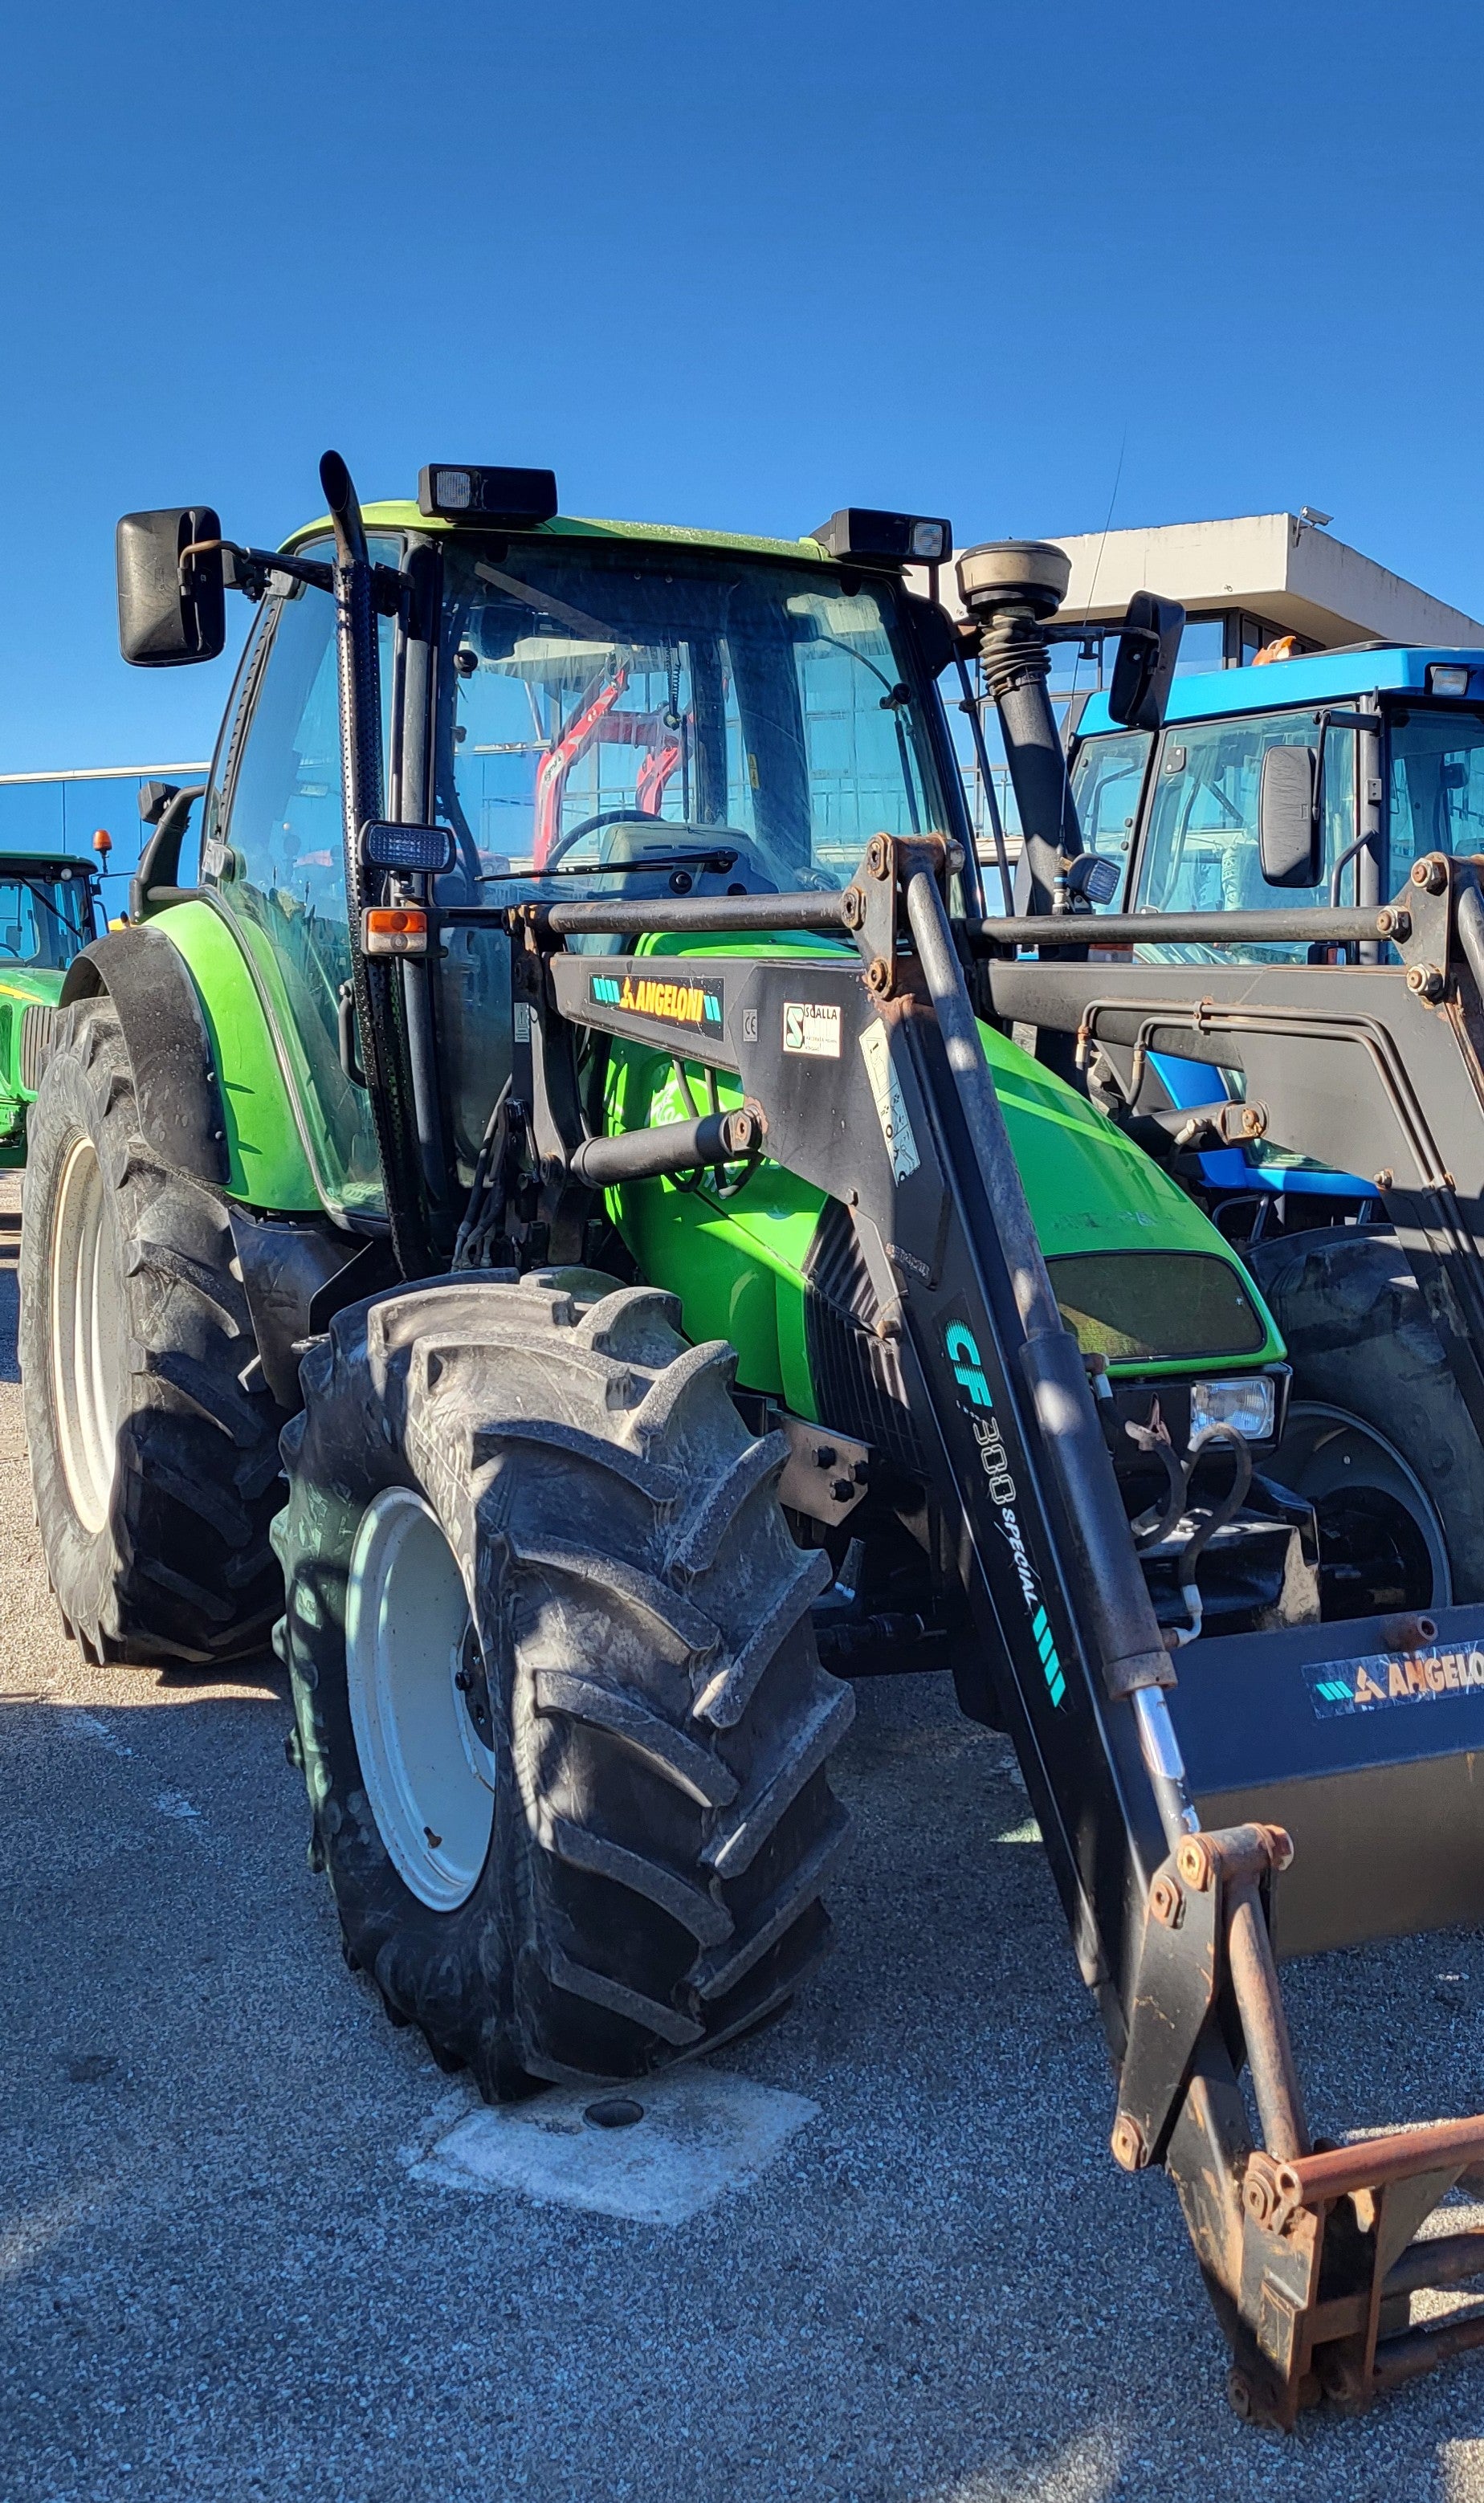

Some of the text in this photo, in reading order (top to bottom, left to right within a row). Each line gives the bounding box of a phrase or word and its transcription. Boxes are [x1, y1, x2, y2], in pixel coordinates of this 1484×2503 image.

[634, 980, 704, 1022] ANGELONI
[744, 1015, 756, 1035] CE
[946, 1319, 1038, 1605] CF 300 SPECIAL
